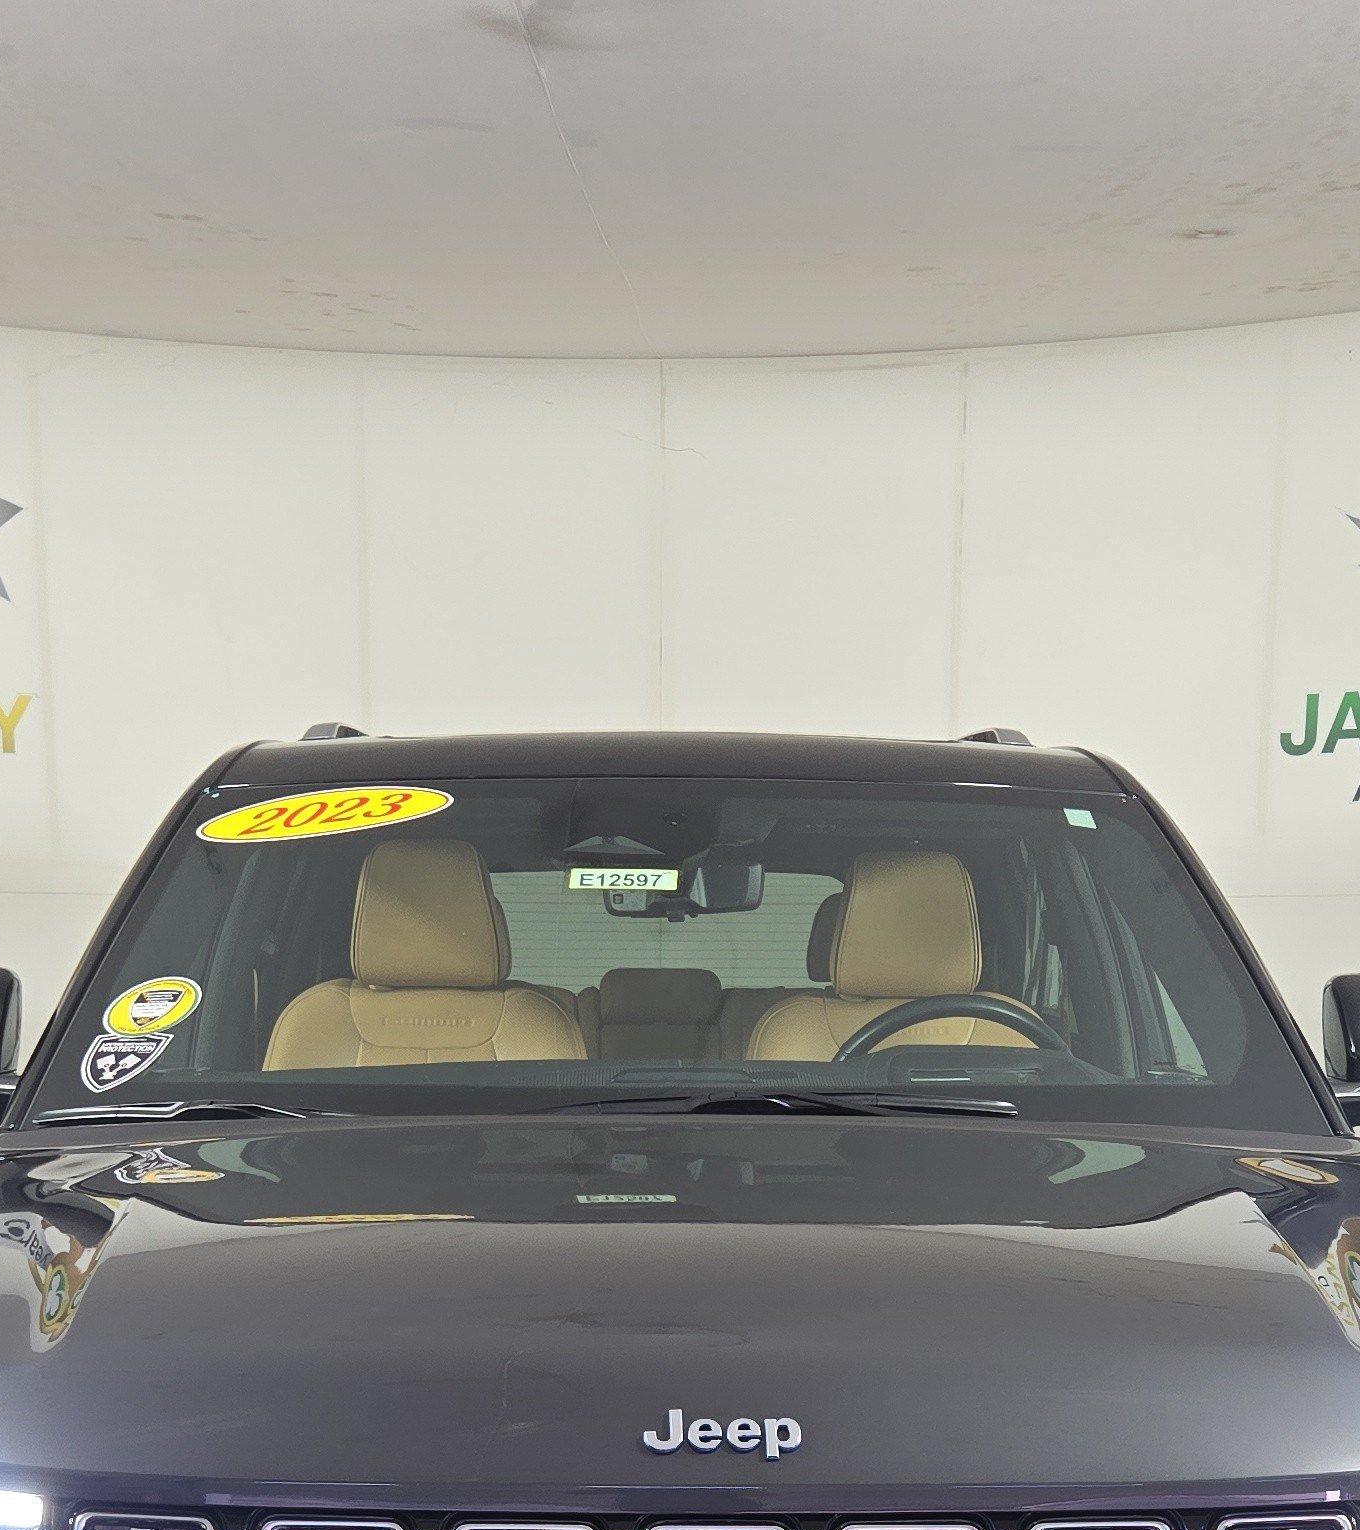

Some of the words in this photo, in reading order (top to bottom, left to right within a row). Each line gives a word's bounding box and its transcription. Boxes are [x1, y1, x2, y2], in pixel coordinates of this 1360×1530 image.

[237, 793, 413, 836] 2023
[579, 873, 663, 887] E12597
[643, 1409, 802, 1461] Jeep
